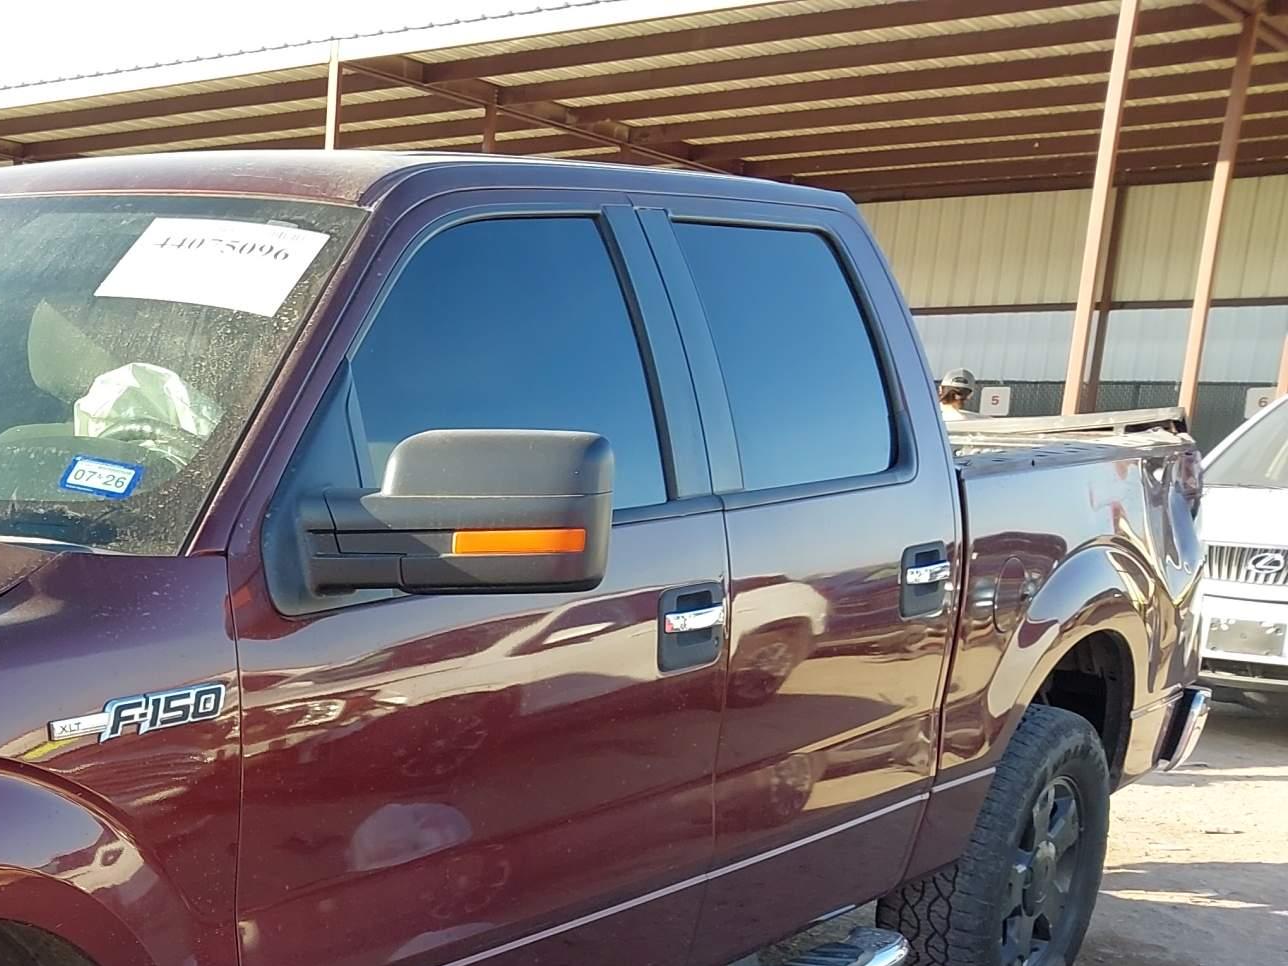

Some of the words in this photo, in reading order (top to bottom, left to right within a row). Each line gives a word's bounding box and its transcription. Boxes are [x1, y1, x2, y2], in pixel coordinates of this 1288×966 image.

[991, 395, 1000, 406] 5
[1258, 396, 1268, 408] 6
[58, 720, 82, 735] XLT
[106, 684, 224, 738] F-150
